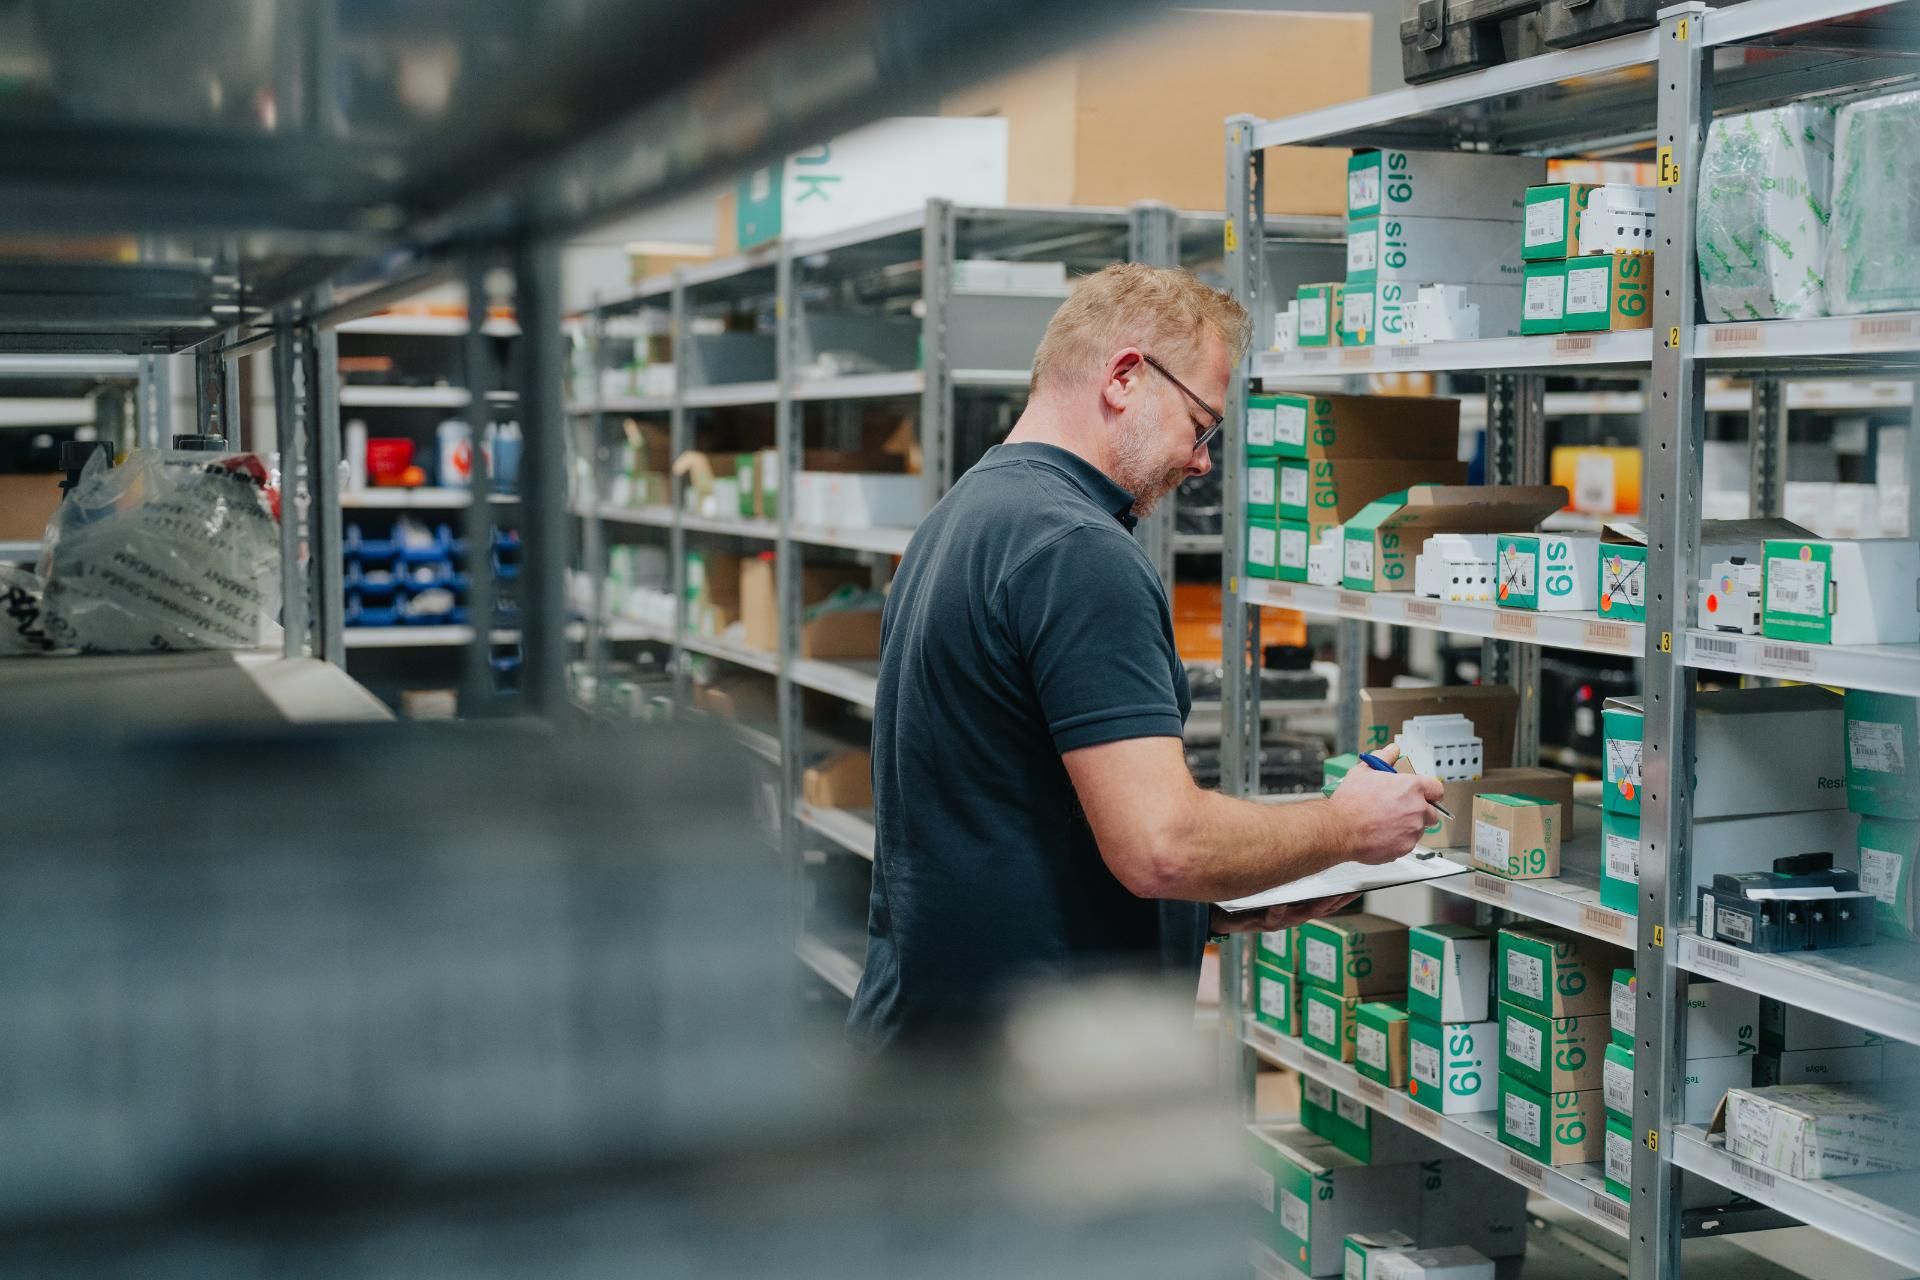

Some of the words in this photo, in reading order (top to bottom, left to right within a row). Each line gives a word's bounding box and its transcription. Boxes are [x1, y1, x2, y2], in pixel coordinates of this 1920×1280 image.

[1387, 153, 1413, 203] si9
[1385, 221, 1407, 269] si9
[1618, 258, 1648, 317] si9
[1672, 328, 1679, 345] 2
[1315, 462, 1339, 509] si9
[1546, 542, 1574, 597] si9
[1663, 634, 1670, 651] 3
[1490, 848, 1546, 876] si9
[1655, 929, 1662, 944] 4
[1556, 1017, 1587, 1072] si9
[1556, 1093, 1587, 1146] si9
[1650, 1132, 1656, 1149] 5
